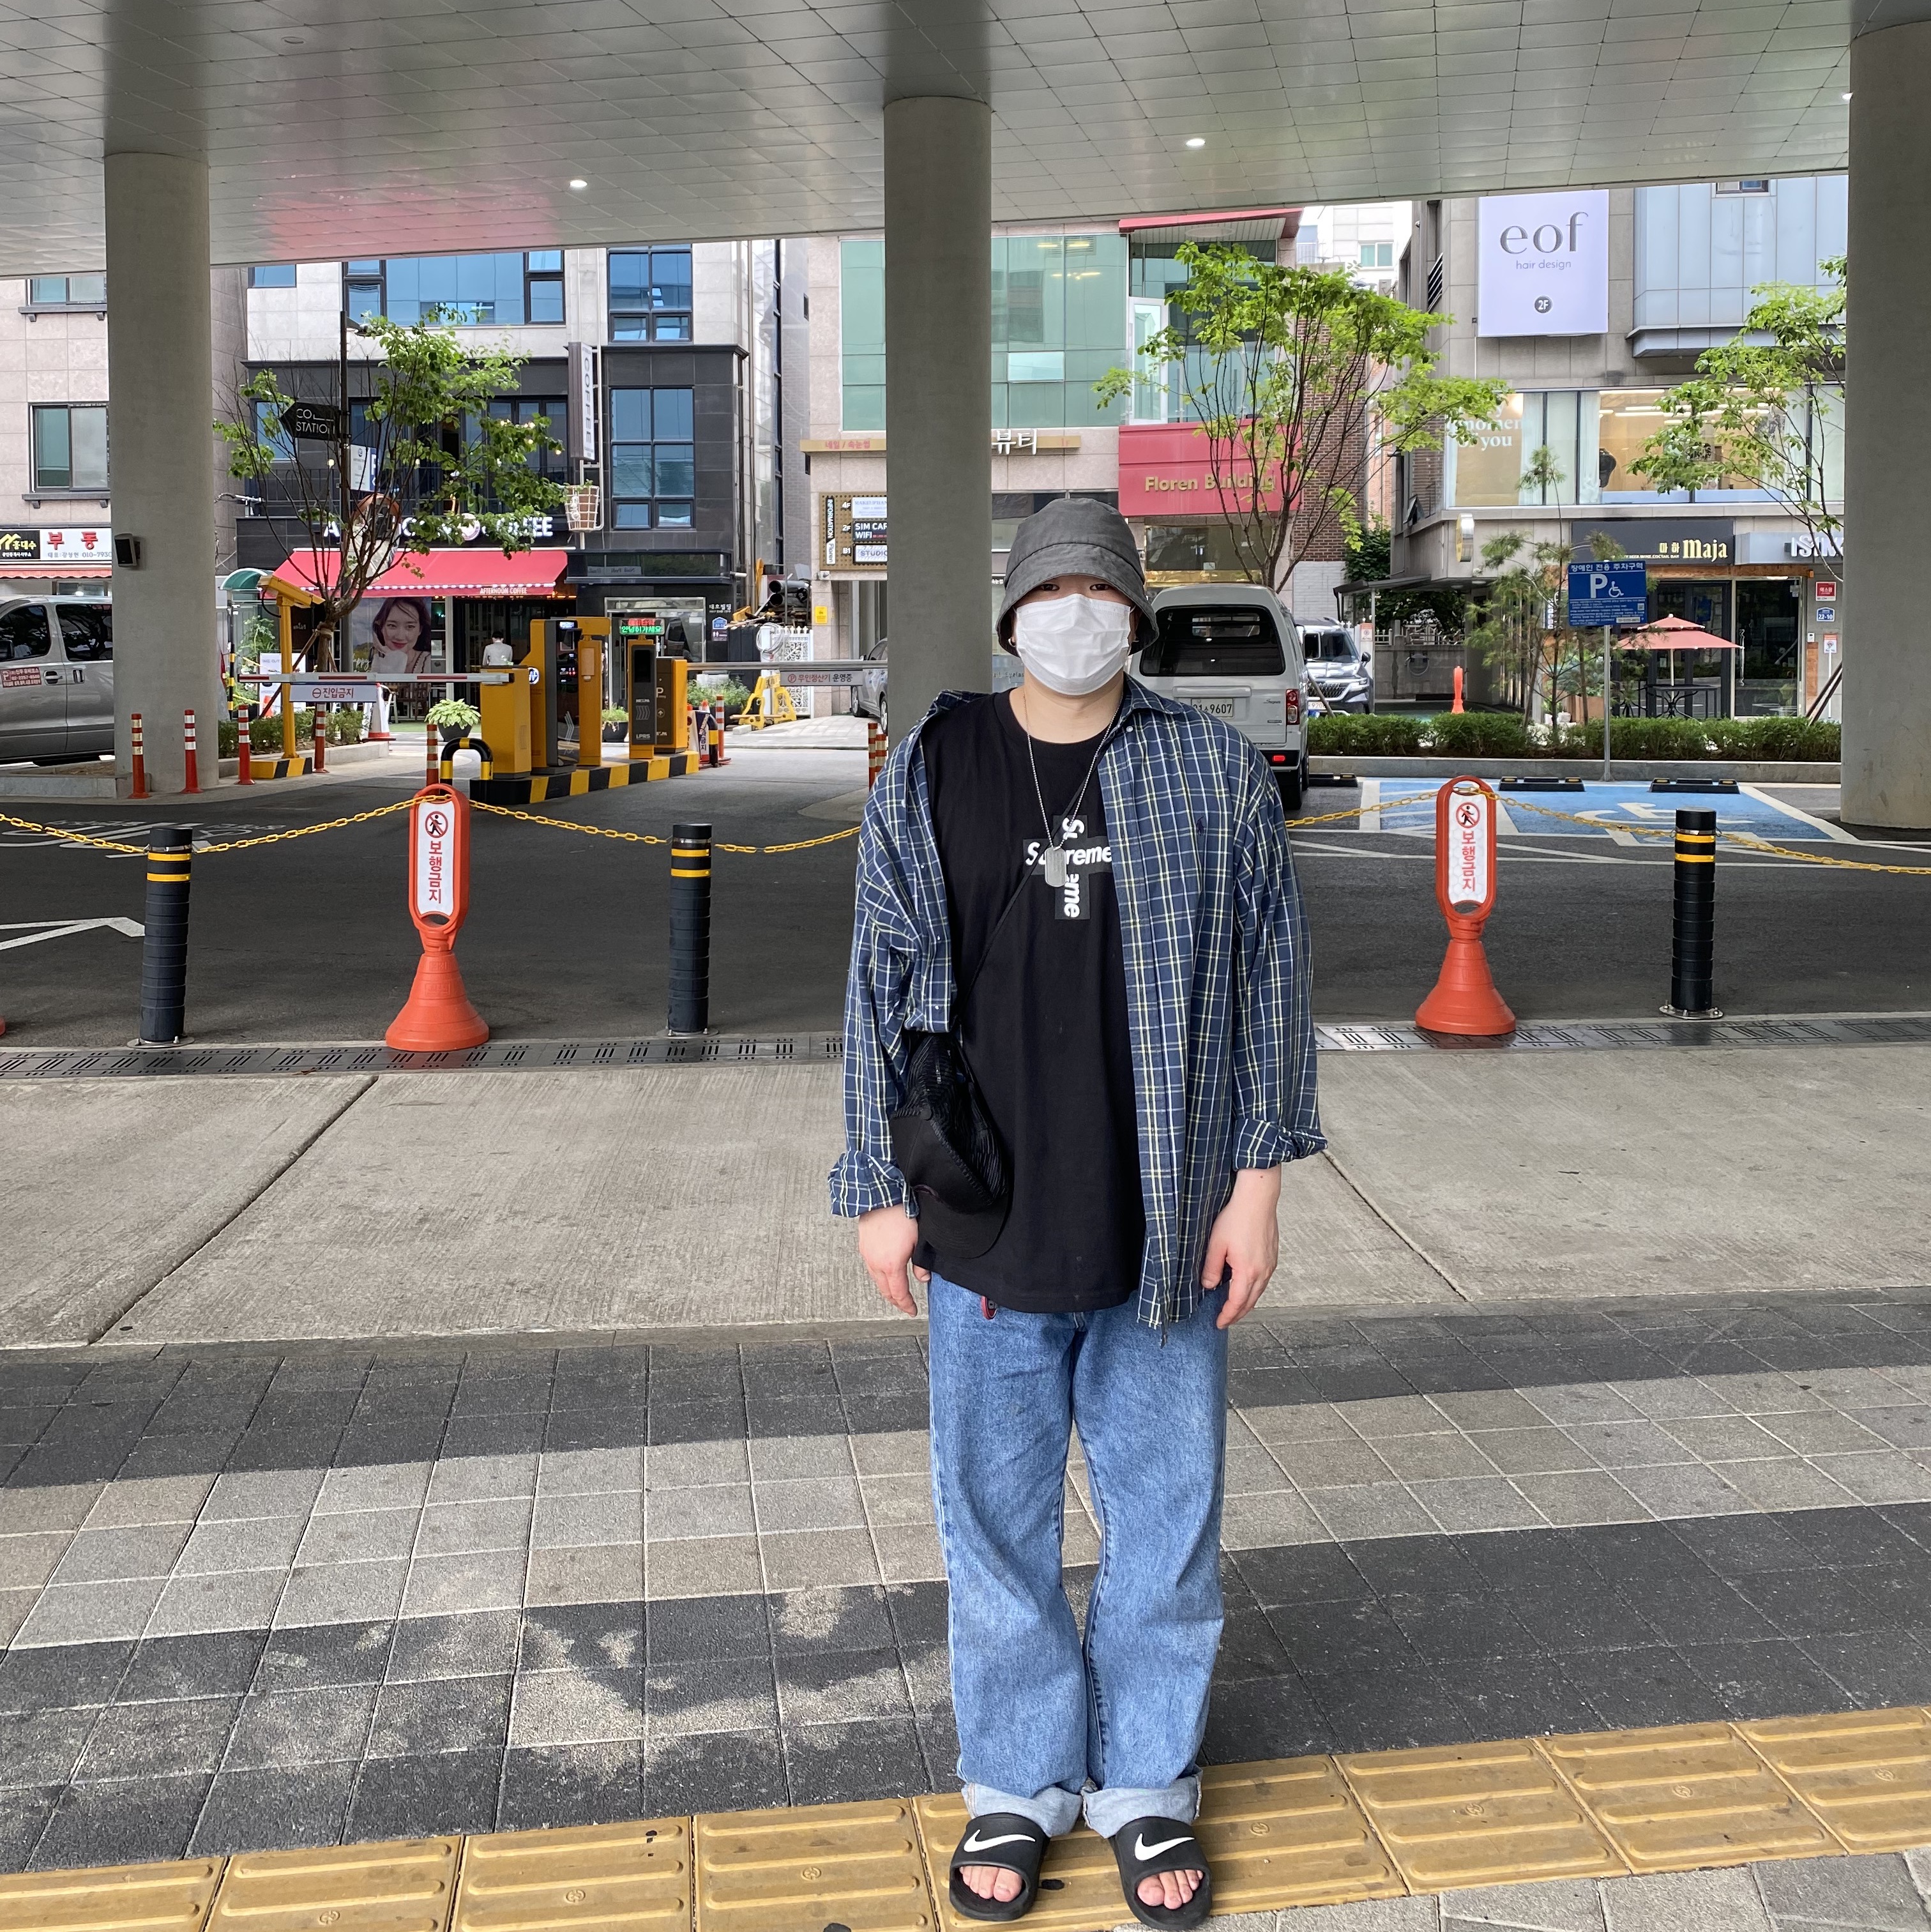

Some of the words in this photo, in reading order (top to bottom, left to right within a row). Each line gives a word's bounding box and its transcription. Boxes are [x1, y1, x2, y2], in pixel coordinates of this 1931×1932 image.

[1500, 211, 1589, 254] eof
[1516, 260, 1536, 270] hair
[1538, 259, 1571, 271] design
[1538, 300, 1549, 310] 2F
[825, 441, 840, 450] 네일
[991, 429, 1037, 455] 뷰티
[1481, 436, 1512, 452] you
[1145, 476, 1199, 491] Floren
[854, 522, 870, 531] SIM
[855, 531, 872, 539] WIFI
[1683, 538, 1729, 562] Maja
[1613, 562, 1644, 570] 주차구역
[1590, 574, 1608, 598] P
[798, 674, 831, 683] 무인정산기
[832, 673, 853, 683] 운영중
[322, 687, 354, 699] 진입금지
[1025, 842, 1112, 865] Sreme
[1461, 830, 1476, 892] 보행금지
[428, 840, 443, 904] 보행금지
